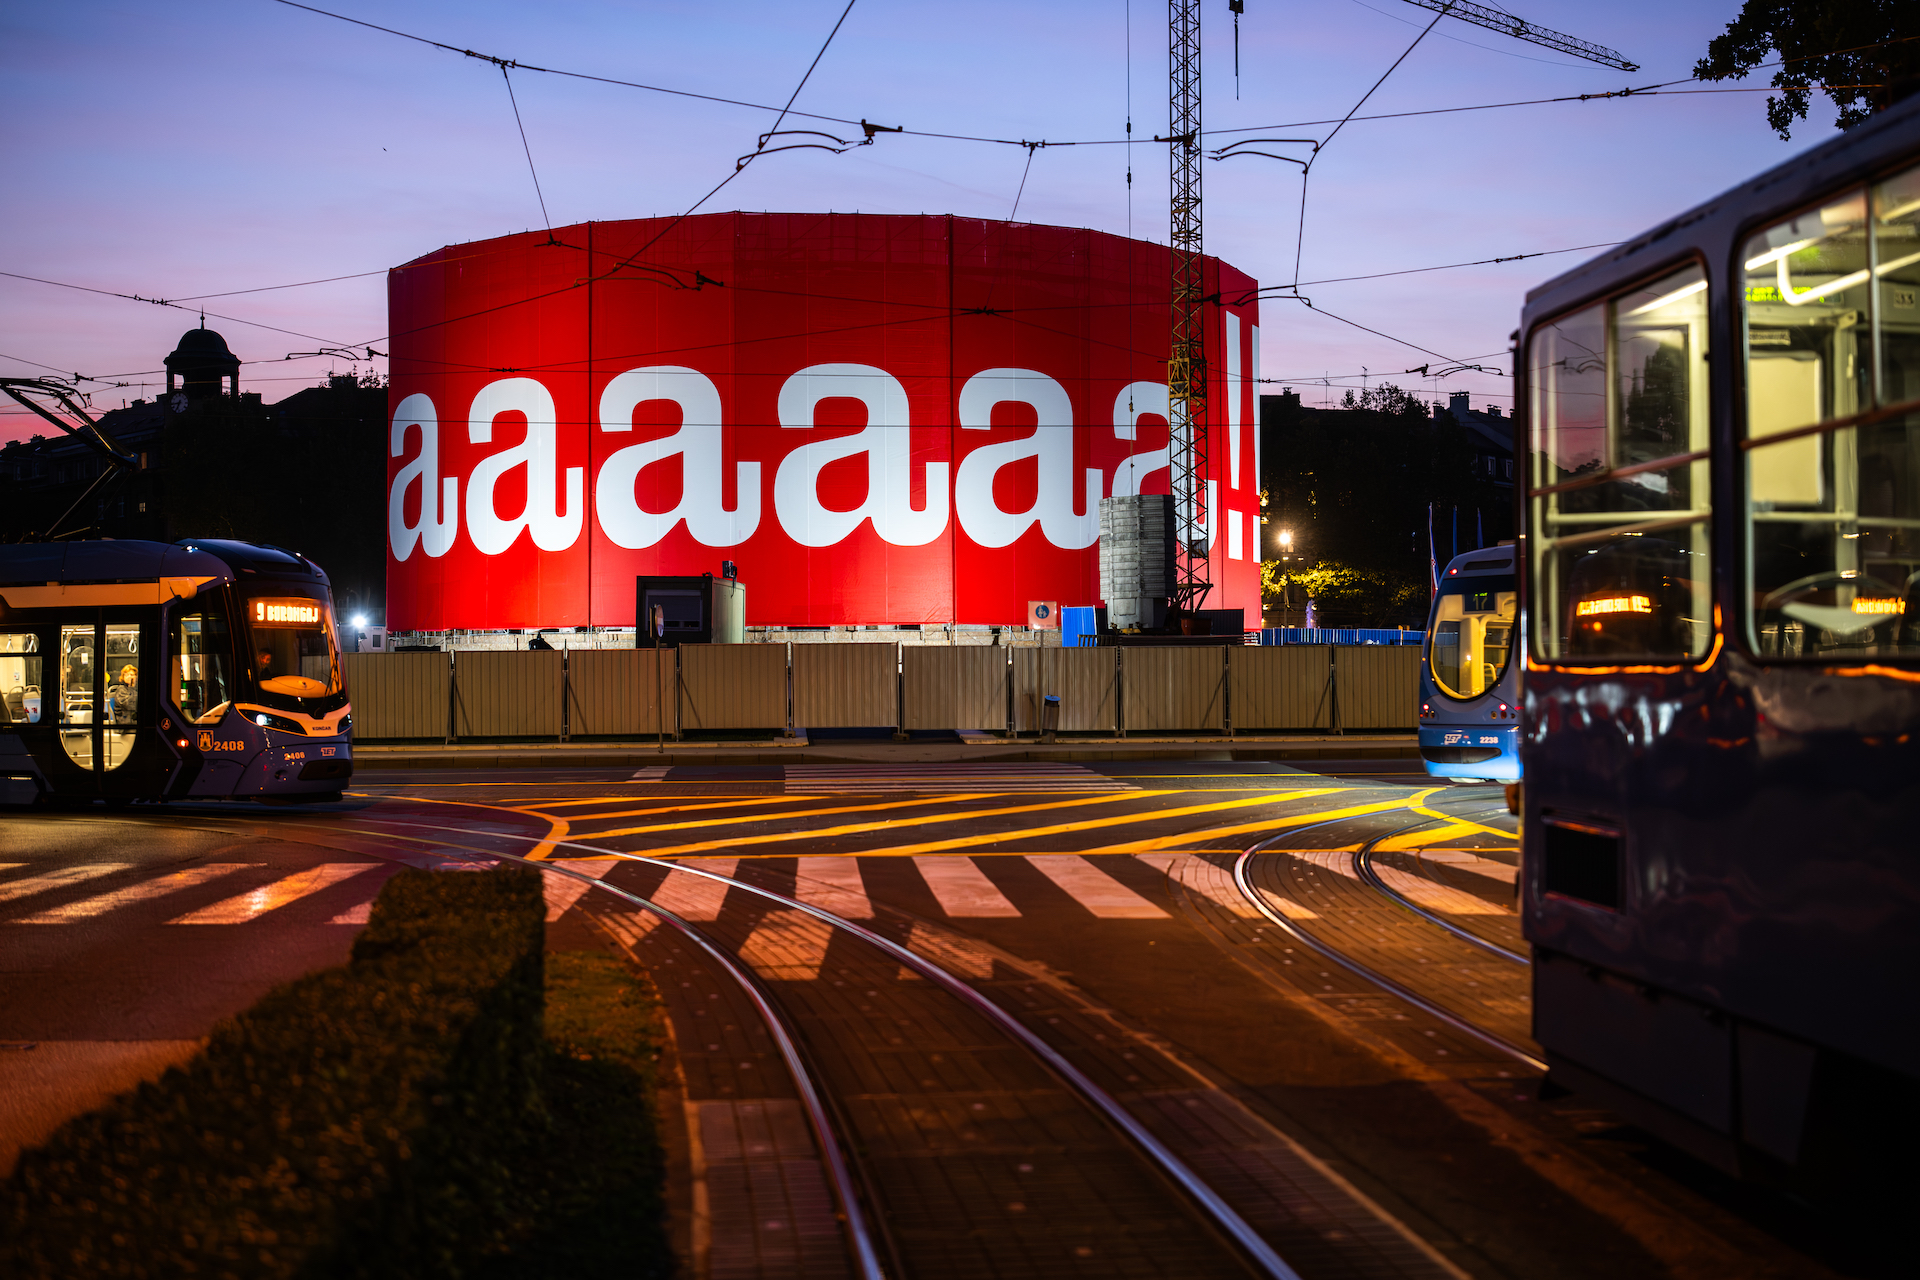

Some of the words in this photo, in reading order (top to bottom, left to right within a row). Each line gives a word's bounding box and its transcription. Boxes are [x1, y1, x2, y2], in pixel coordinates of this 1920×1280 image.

[257, 603, 264, 621] 9
[214, 740, 244, 751] 2408
[284, 752, 305, 760] 2408
